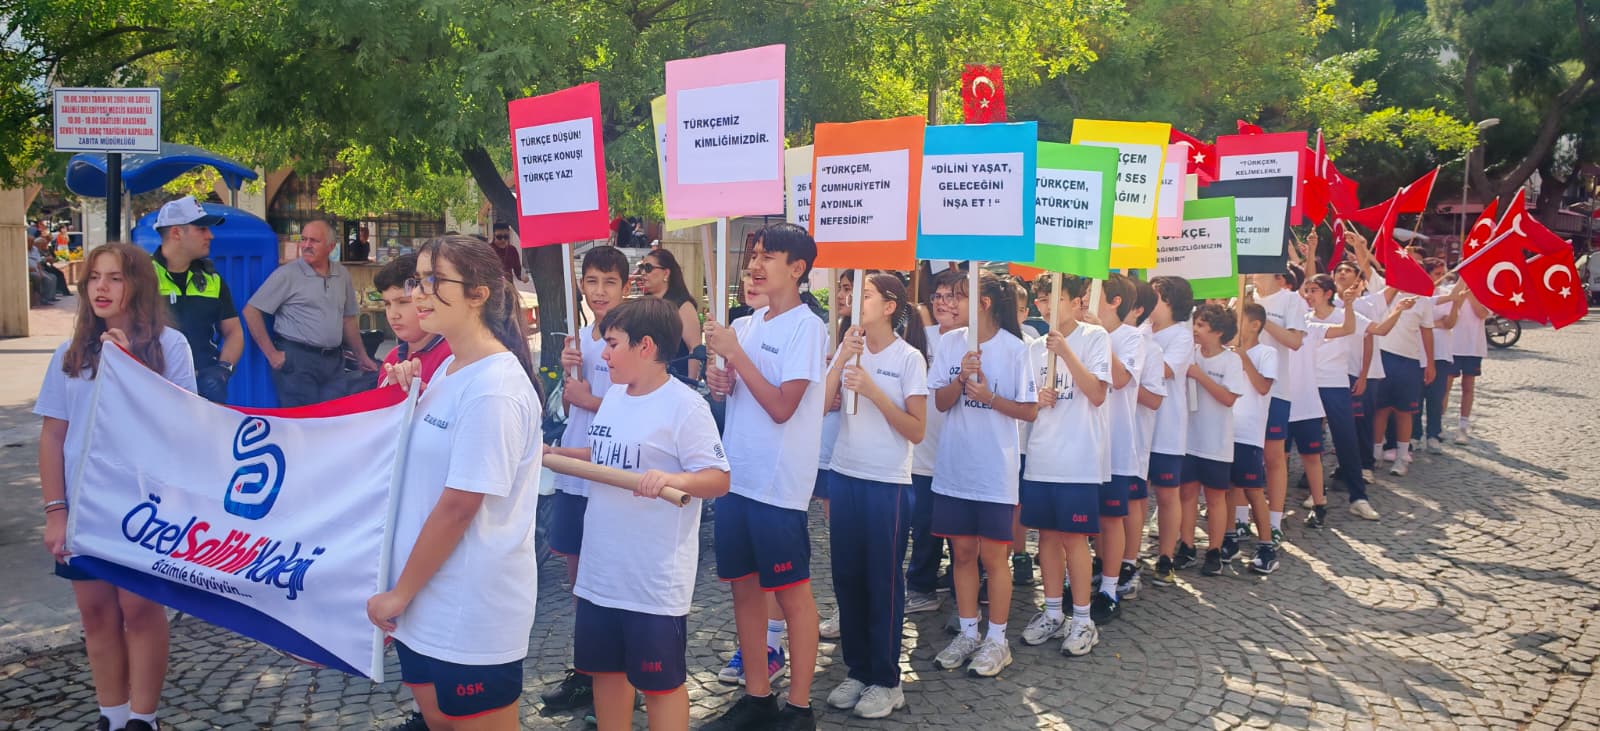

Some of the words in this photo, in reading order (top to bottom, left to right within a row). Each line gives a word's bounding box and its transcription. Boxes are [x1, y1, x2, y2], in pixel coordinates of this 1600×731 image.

[107, 95, 113, 104] VE
[683, 114, 740, 130] TÜRKÇEMİZ
[520, 134, 552, 147] TÜRKÇE
[552, 130, 582, 145] DÜŞÜN!
[694, 133, 769, 149] KİMLİĞİMİZDİR.
[522, 153, 552, 166] TÜRKÇE
[554, 149, 583, 162] KONUŞ!
[972, 163, 1012, 174] YAŞAT,
[524, 171, 554, 184] TÜRKÇE
[555, 169, 573, 180] YAZ!
[1125, 174, 1146, 184] SES
[821, 180, 890, 193] CUMHURİYETİN
[938, 178, 1004, 191] GELECEĞİNİ
[820, 199, 863, 209] AYDINLIK
[943, 197, 968, 209] İNŞA
[971, 198, 984, 208] ET
[774, 561, 792, 573] ÖSK
[456, 682, 485, 696] ÖSK
